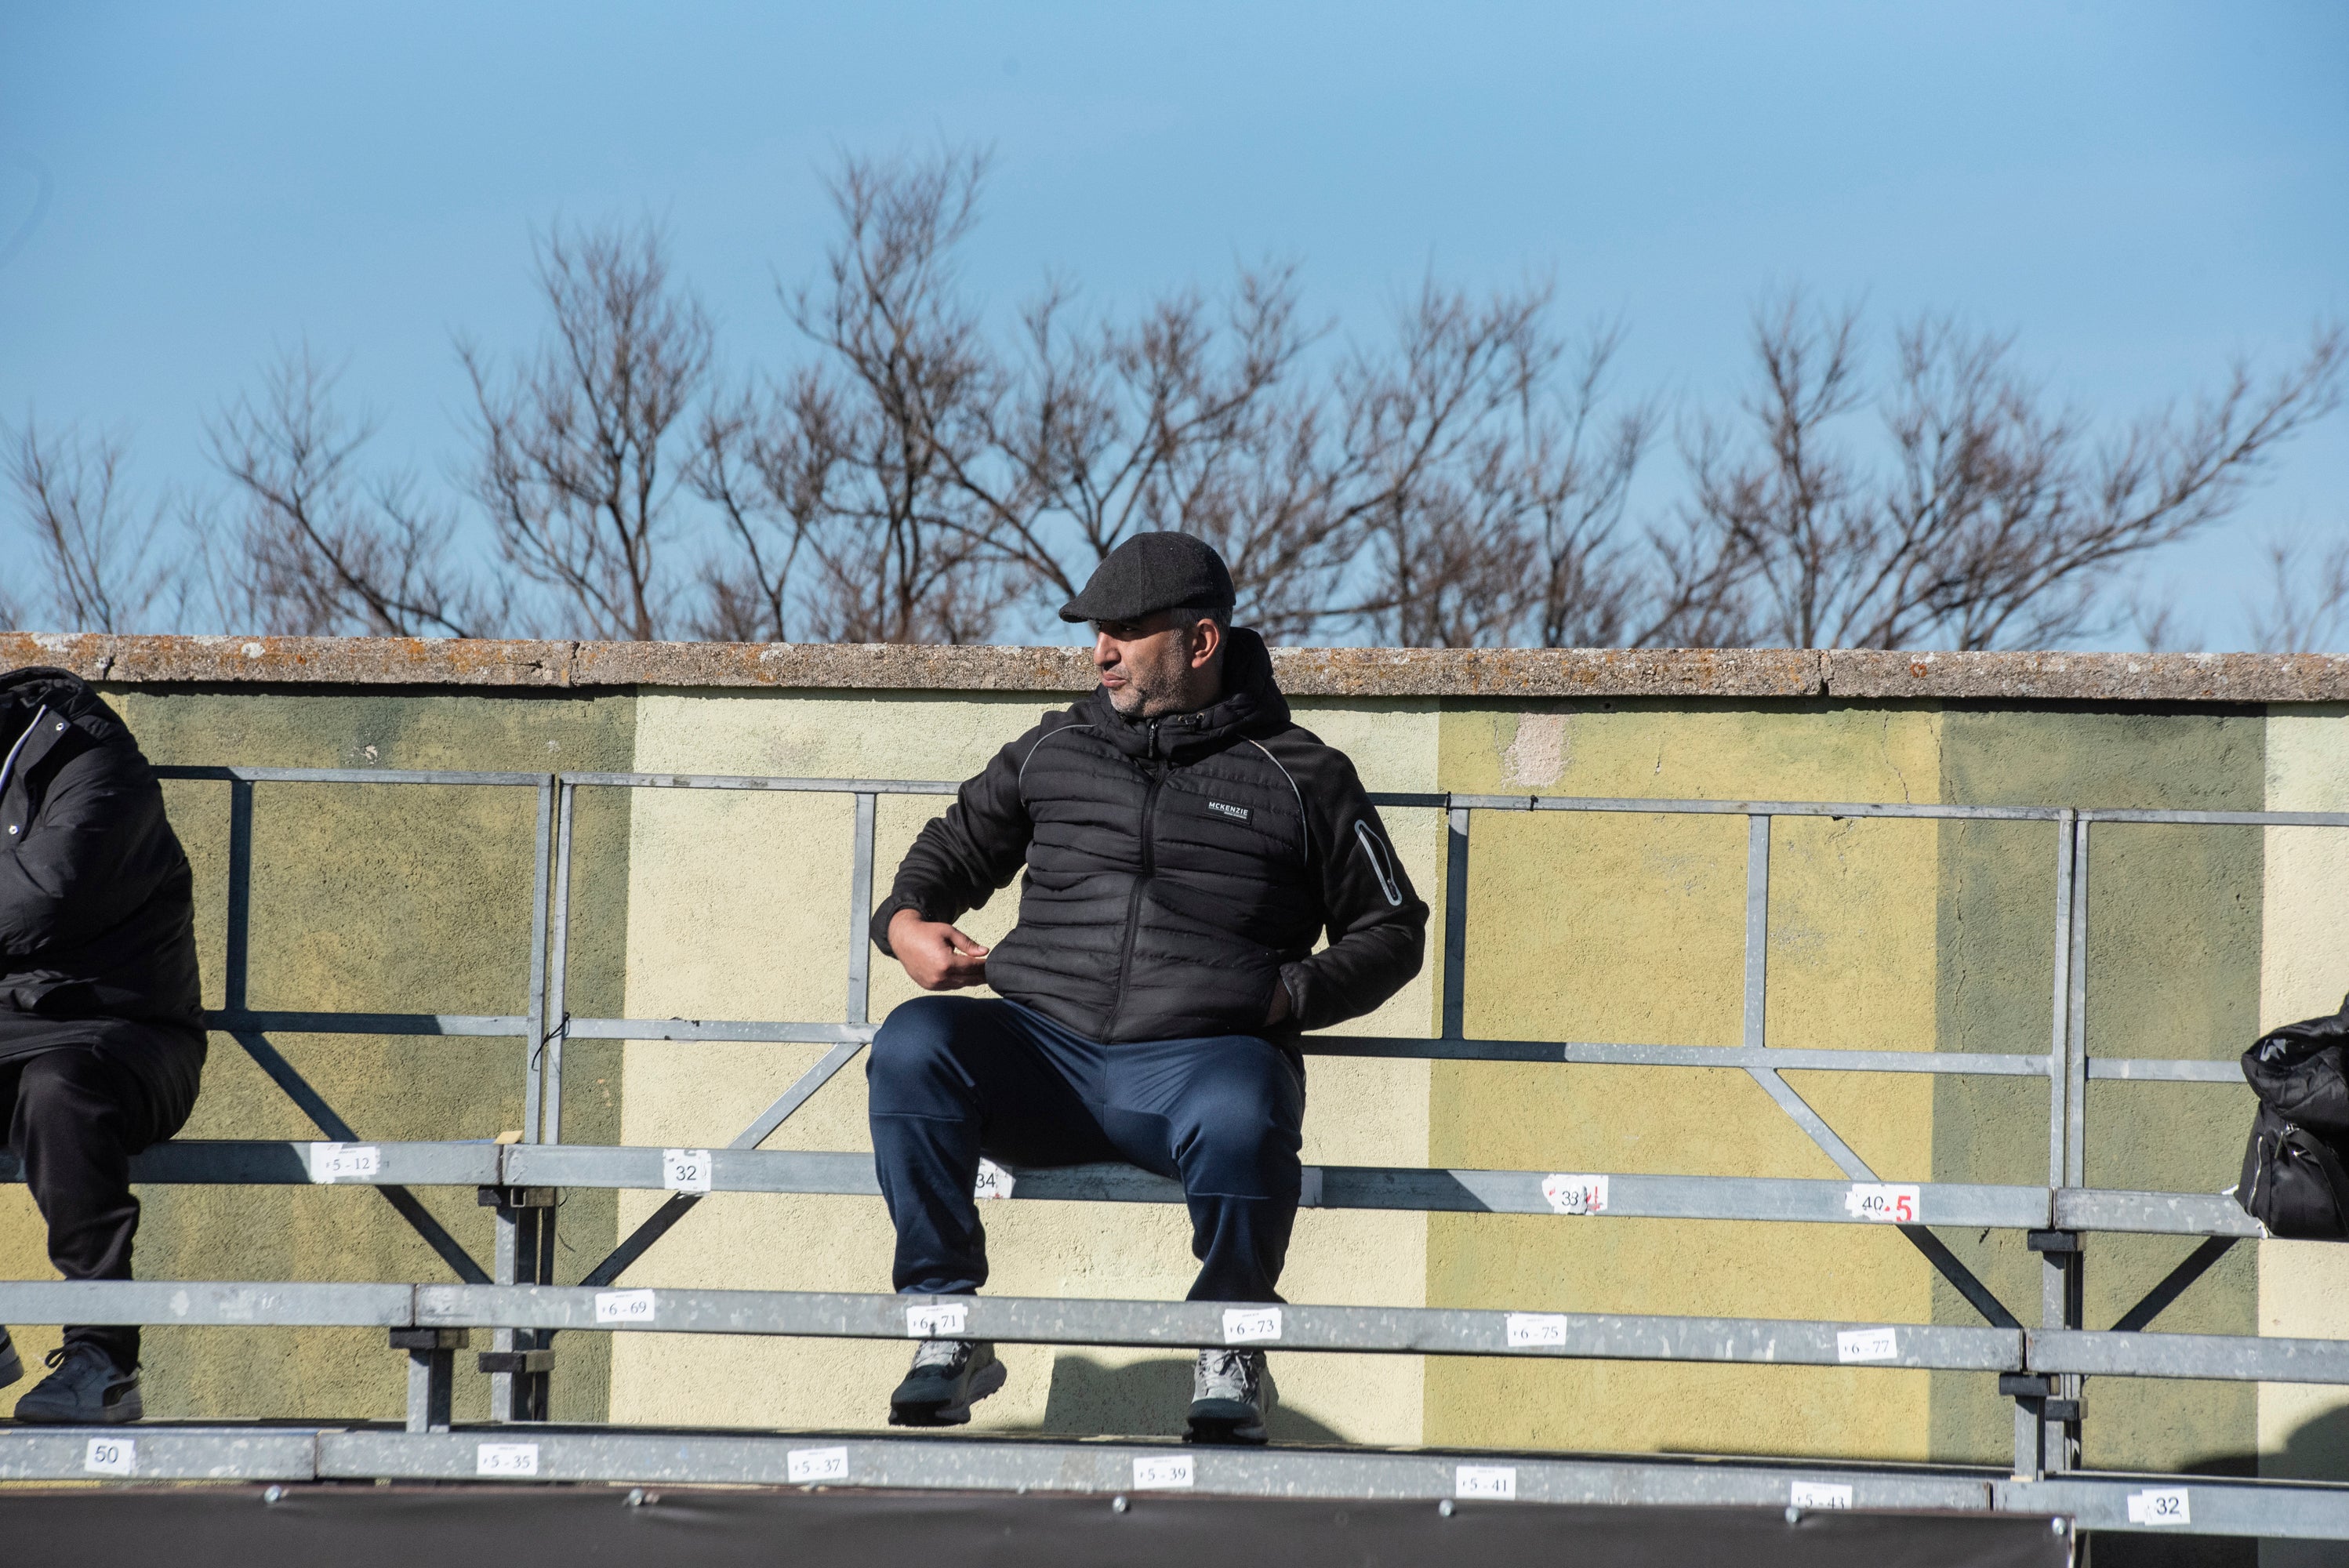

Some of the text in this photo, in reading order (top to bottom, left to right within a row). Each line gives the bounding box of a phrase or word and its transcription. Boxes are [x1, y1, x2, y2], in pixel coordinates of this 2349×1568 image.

[1208, 801, 1248, 815] MCKENZIE
[355, 1157, 370, 1170] 12
[676, 1165, 696, 1181] 32
[976, 1173, 996, 1189] 34
[630, 1301, 647, 1314] 69
[942, 1315, 955, 1328] 71
[1258, 1319, 1274, 1333] 73
[1542, 1326, 1559, 1339] 75
[1872, 1339, 1889, 1353] 77
[94, 1446, 119, 1464] 50
[513, 1454, 531, 1469] 35
[824, 1458, 840, 1473] 37
[1170, 1467, 1186, 1481] 39
[1492, 1479, 1506, 1492] 41
[1828, 1495, 1845, 1510] 43
[2156, 1496, 2180, 1515] 32
